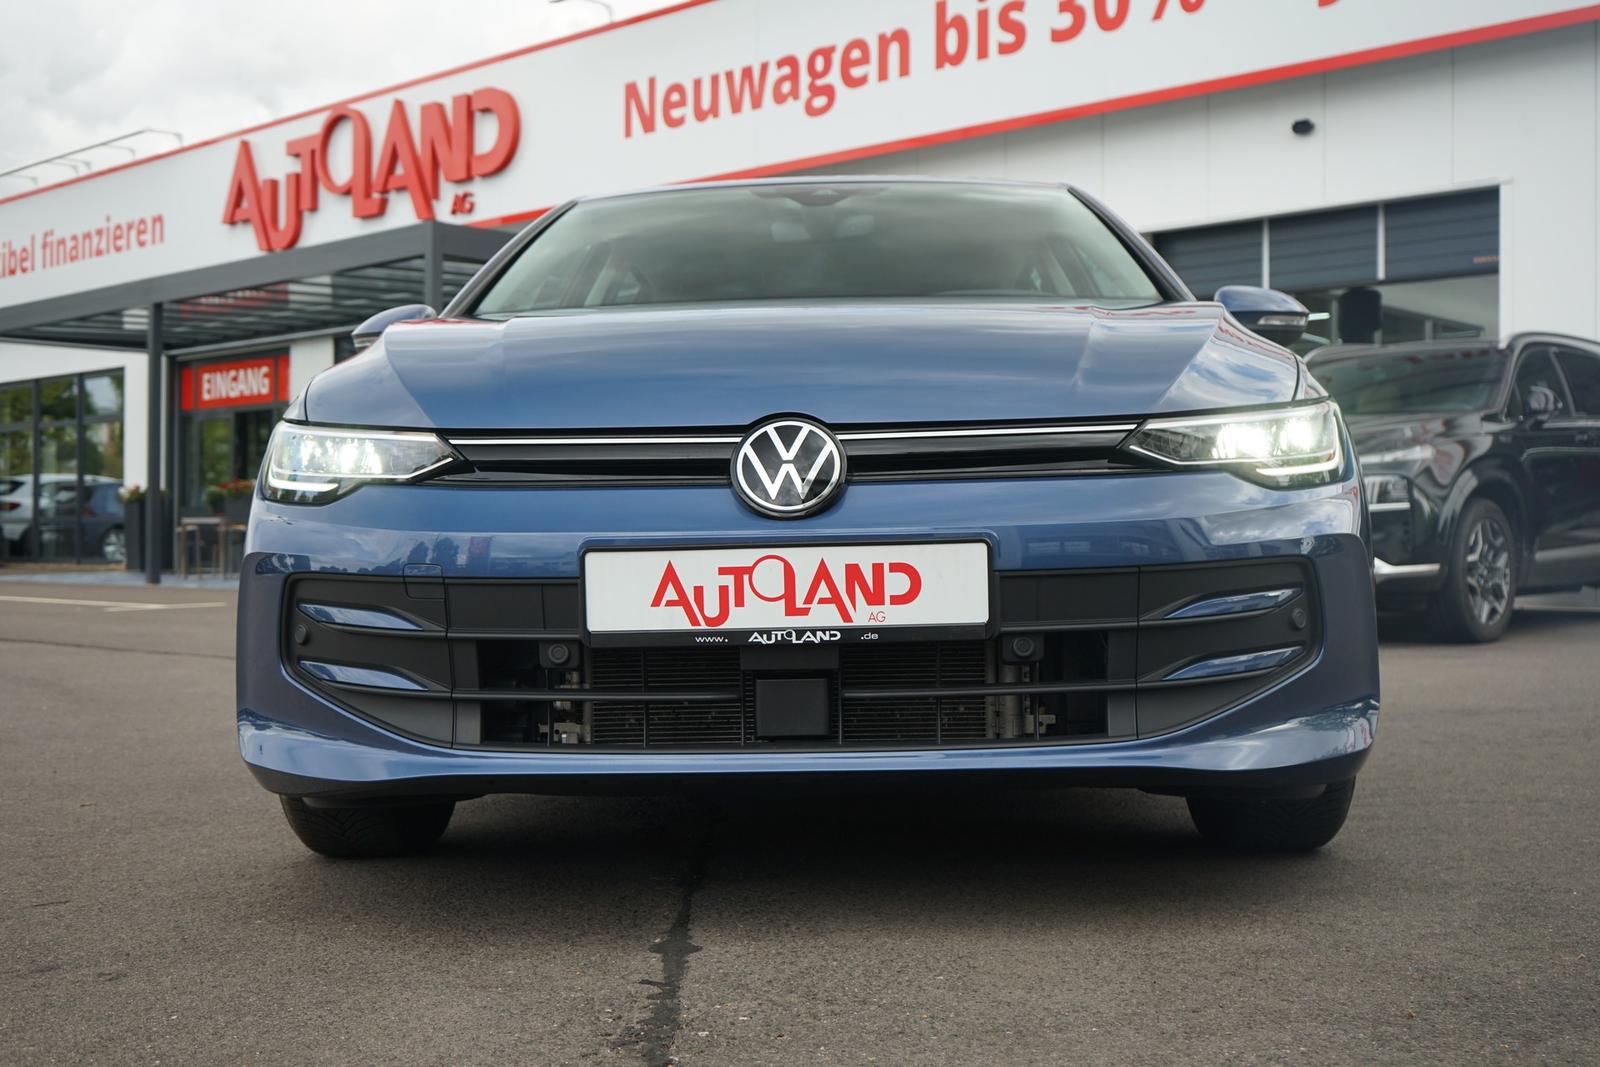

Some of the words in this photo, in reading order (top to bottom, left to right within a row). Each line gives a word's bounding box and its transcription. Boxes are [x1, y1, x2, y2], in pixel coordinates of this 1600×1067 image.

[624, 26, 911, 138] Neuwagen
[934, 0, 1028, 70] bis
[222, 86, 521, 253] AUTOLAND
[451, 192, 475, 216] AG
[41, 213, 165, 269] finanzieren
[202, 365, 270, 401] EINGANG
[737, 420, 841, 511] VW
[650, 554, 923, 628] AUTOLAND
[867, 611, 887, 623] AG
